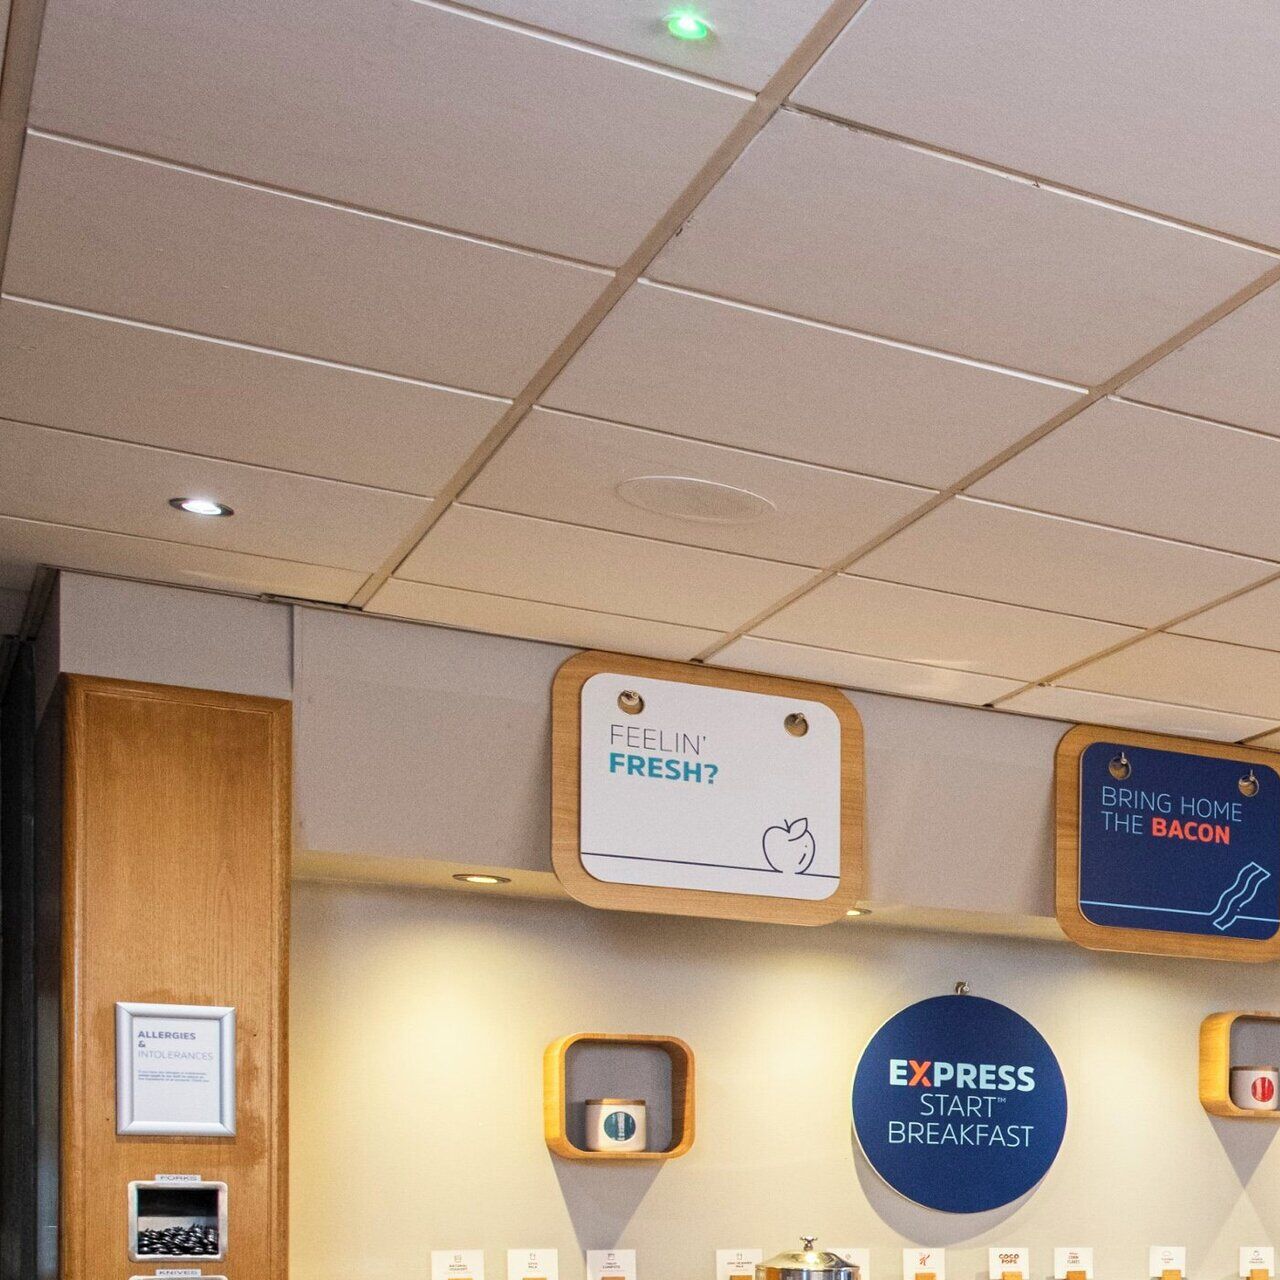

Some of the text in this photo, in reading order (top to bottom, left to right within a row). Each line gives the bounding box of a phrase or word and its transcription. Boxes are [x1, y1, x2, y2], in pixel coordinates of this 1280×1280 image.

[610, 723, 707, 756] FEELIN'
[609, 751, 719, 785] FRESH?
[1101, 785, 1243, 823] BRING HOME
[1100, 810, 1231, 846] THE BACON
[138, 1030, 196, 1040] ALLERGIES
[138, 1040, 146, 1048] &
[138, 1050, 214, 1061] INTOLERANCES
[889, 1059, 1036, 1092] EXPRESS
[888, 1121, 1034, 1148] BREAKFAST
